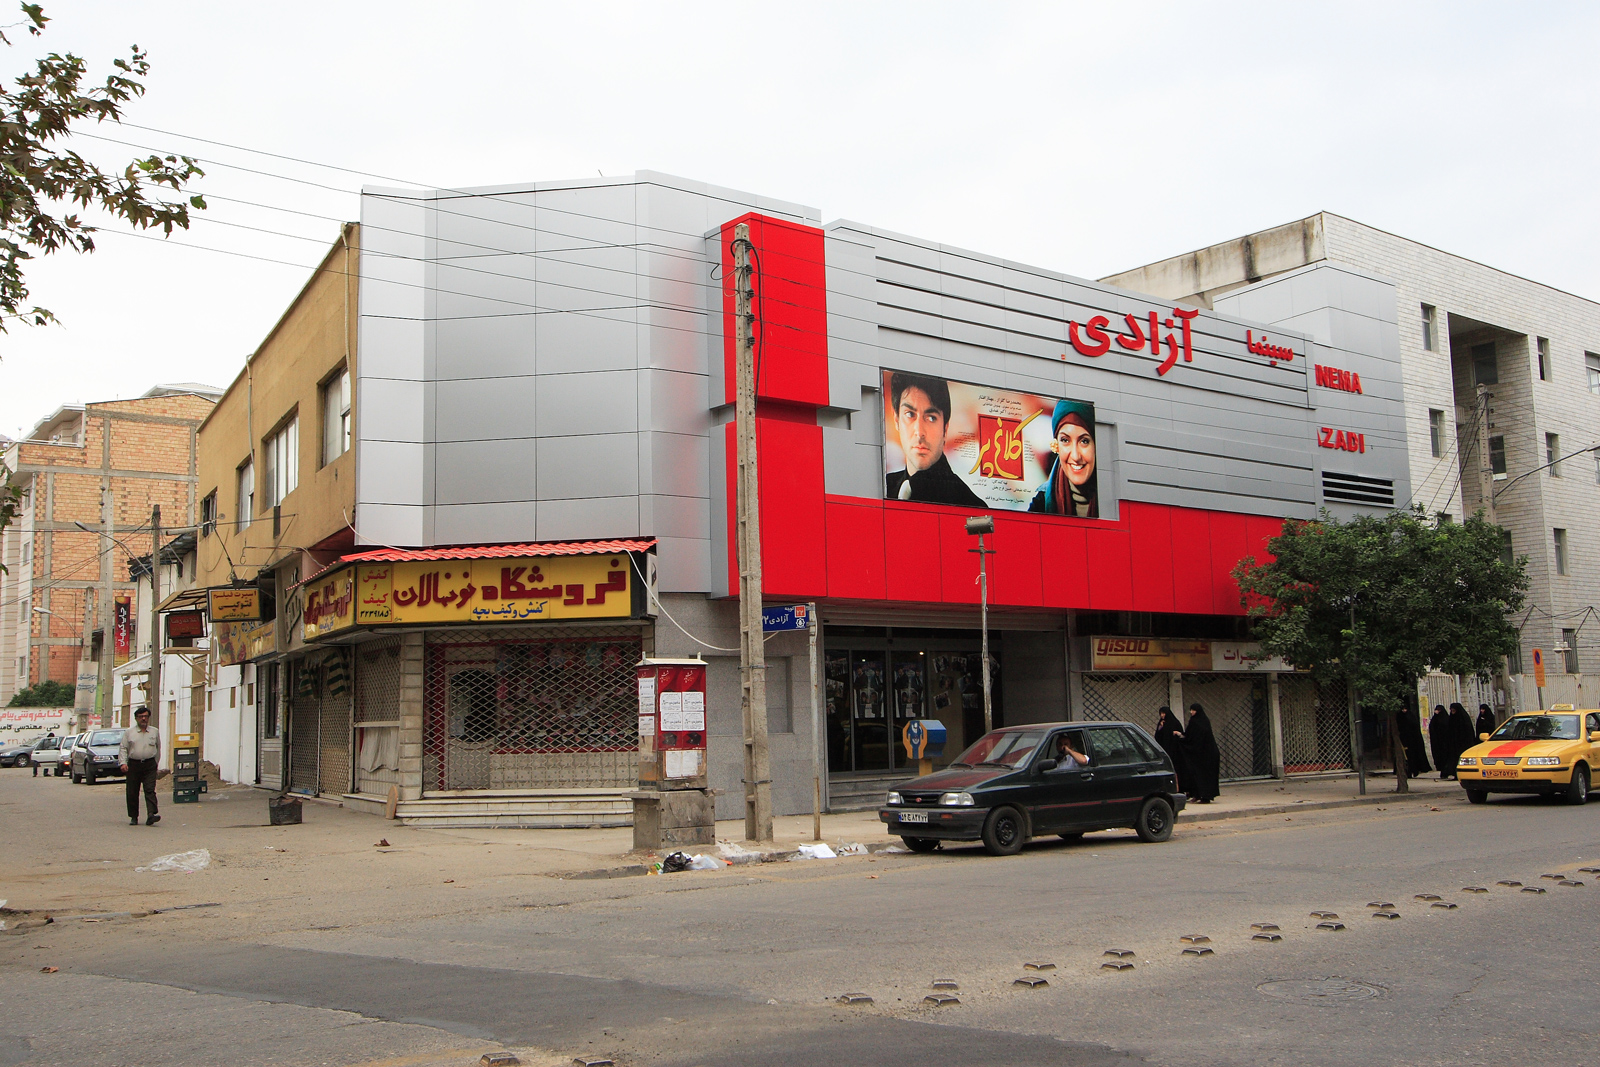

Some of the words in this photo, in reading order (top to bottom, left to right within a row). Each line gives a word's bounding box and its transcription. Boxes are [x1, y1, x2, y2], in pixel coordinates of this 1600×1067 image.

[1069, 307, 1199, 377] آزادی
[1247, 329, 1294, 366] سینما
[994, 408, 1044, 479] کلاغ
[1316, 427, 1366, 453] ZADI
[363, 569, 389, 583] کفش
[481, 558, 627, 606] فروشگاه
[218, 599, 252, 612] فتوکپی
[363, 593, 389, 606] کیف
[472, 605, 491, 620] بچه
[491, 601, 514, 616] کیف
[519, 601, 548, 617] کفش
[769, 613, 789, 625] آزادی
[14, 708, 64, 722] کتابفروشی
[14, 723, 43, 733] مهندسی
[46, 723, 60, 732] فنی
